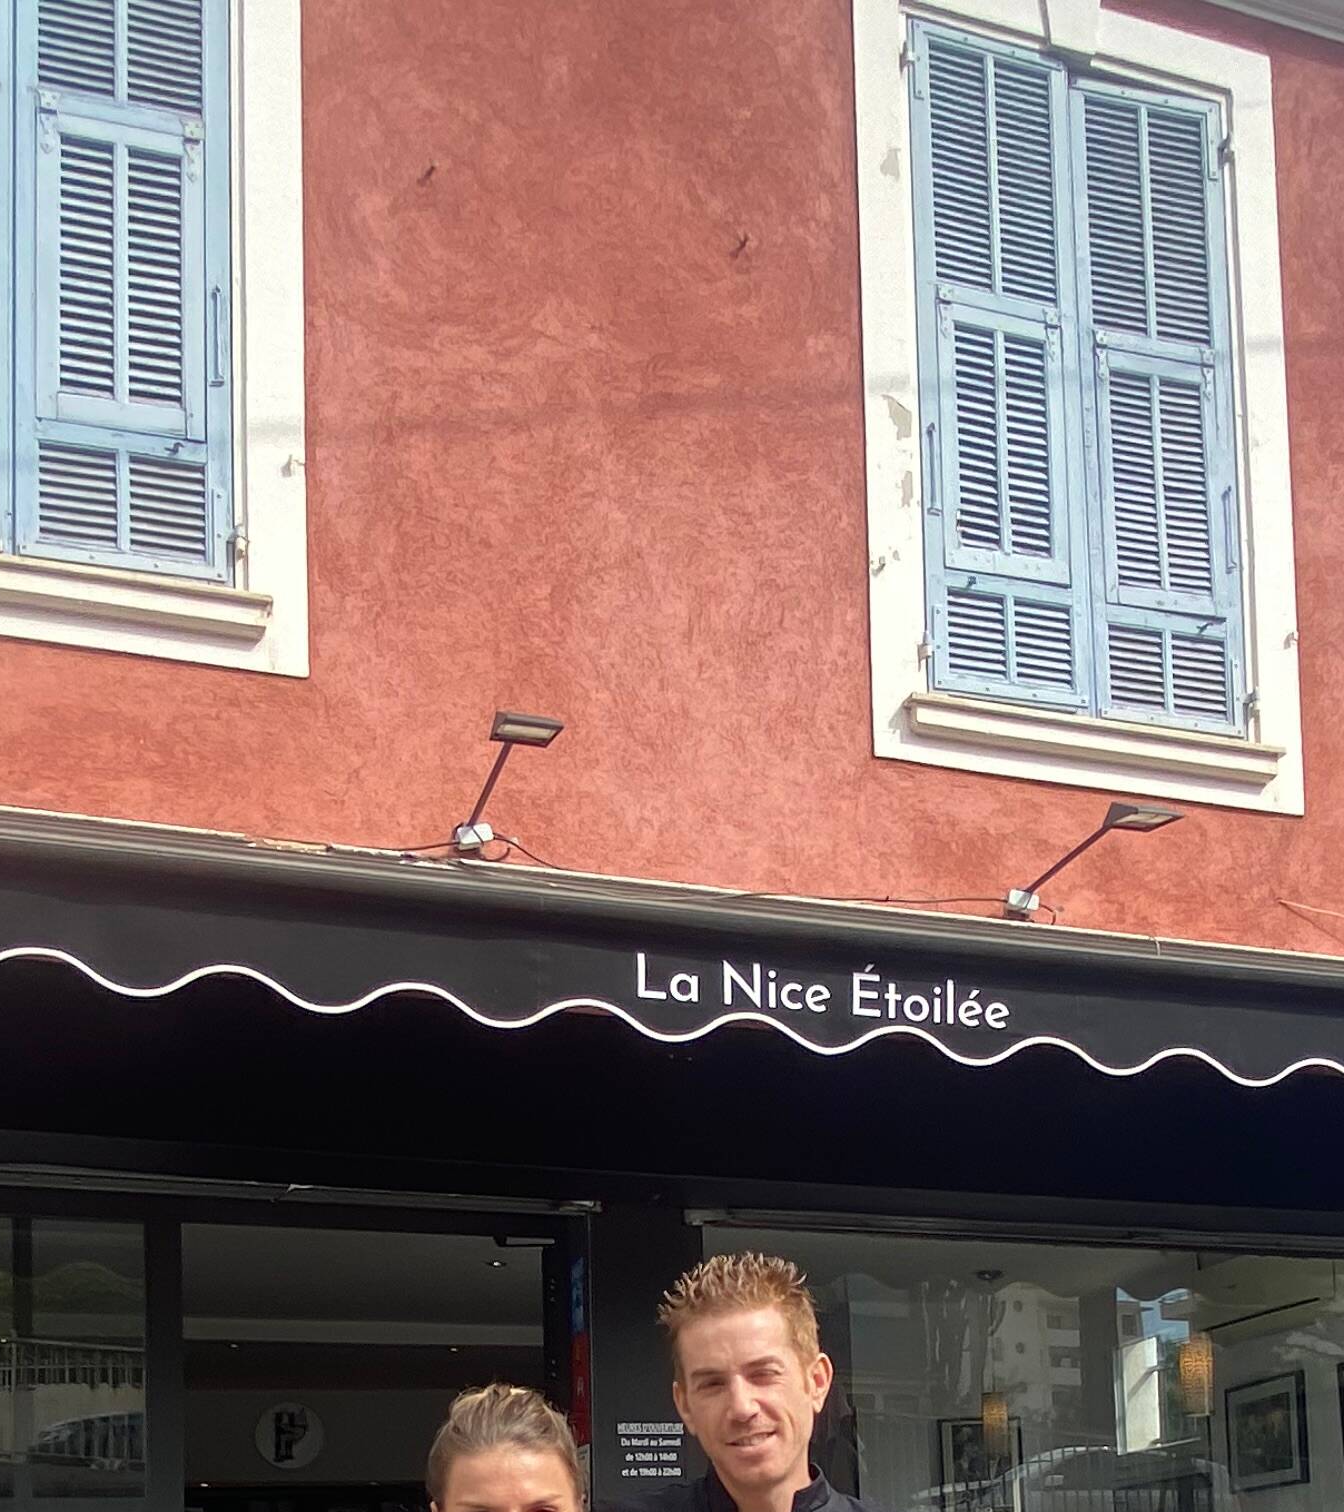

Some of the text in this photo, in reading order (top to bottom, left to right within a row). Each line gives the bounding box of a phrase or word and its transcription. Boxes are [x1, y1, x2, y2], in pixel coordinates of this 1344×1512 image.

[636, 952, 1011, 1030] La Nice Étoilée
